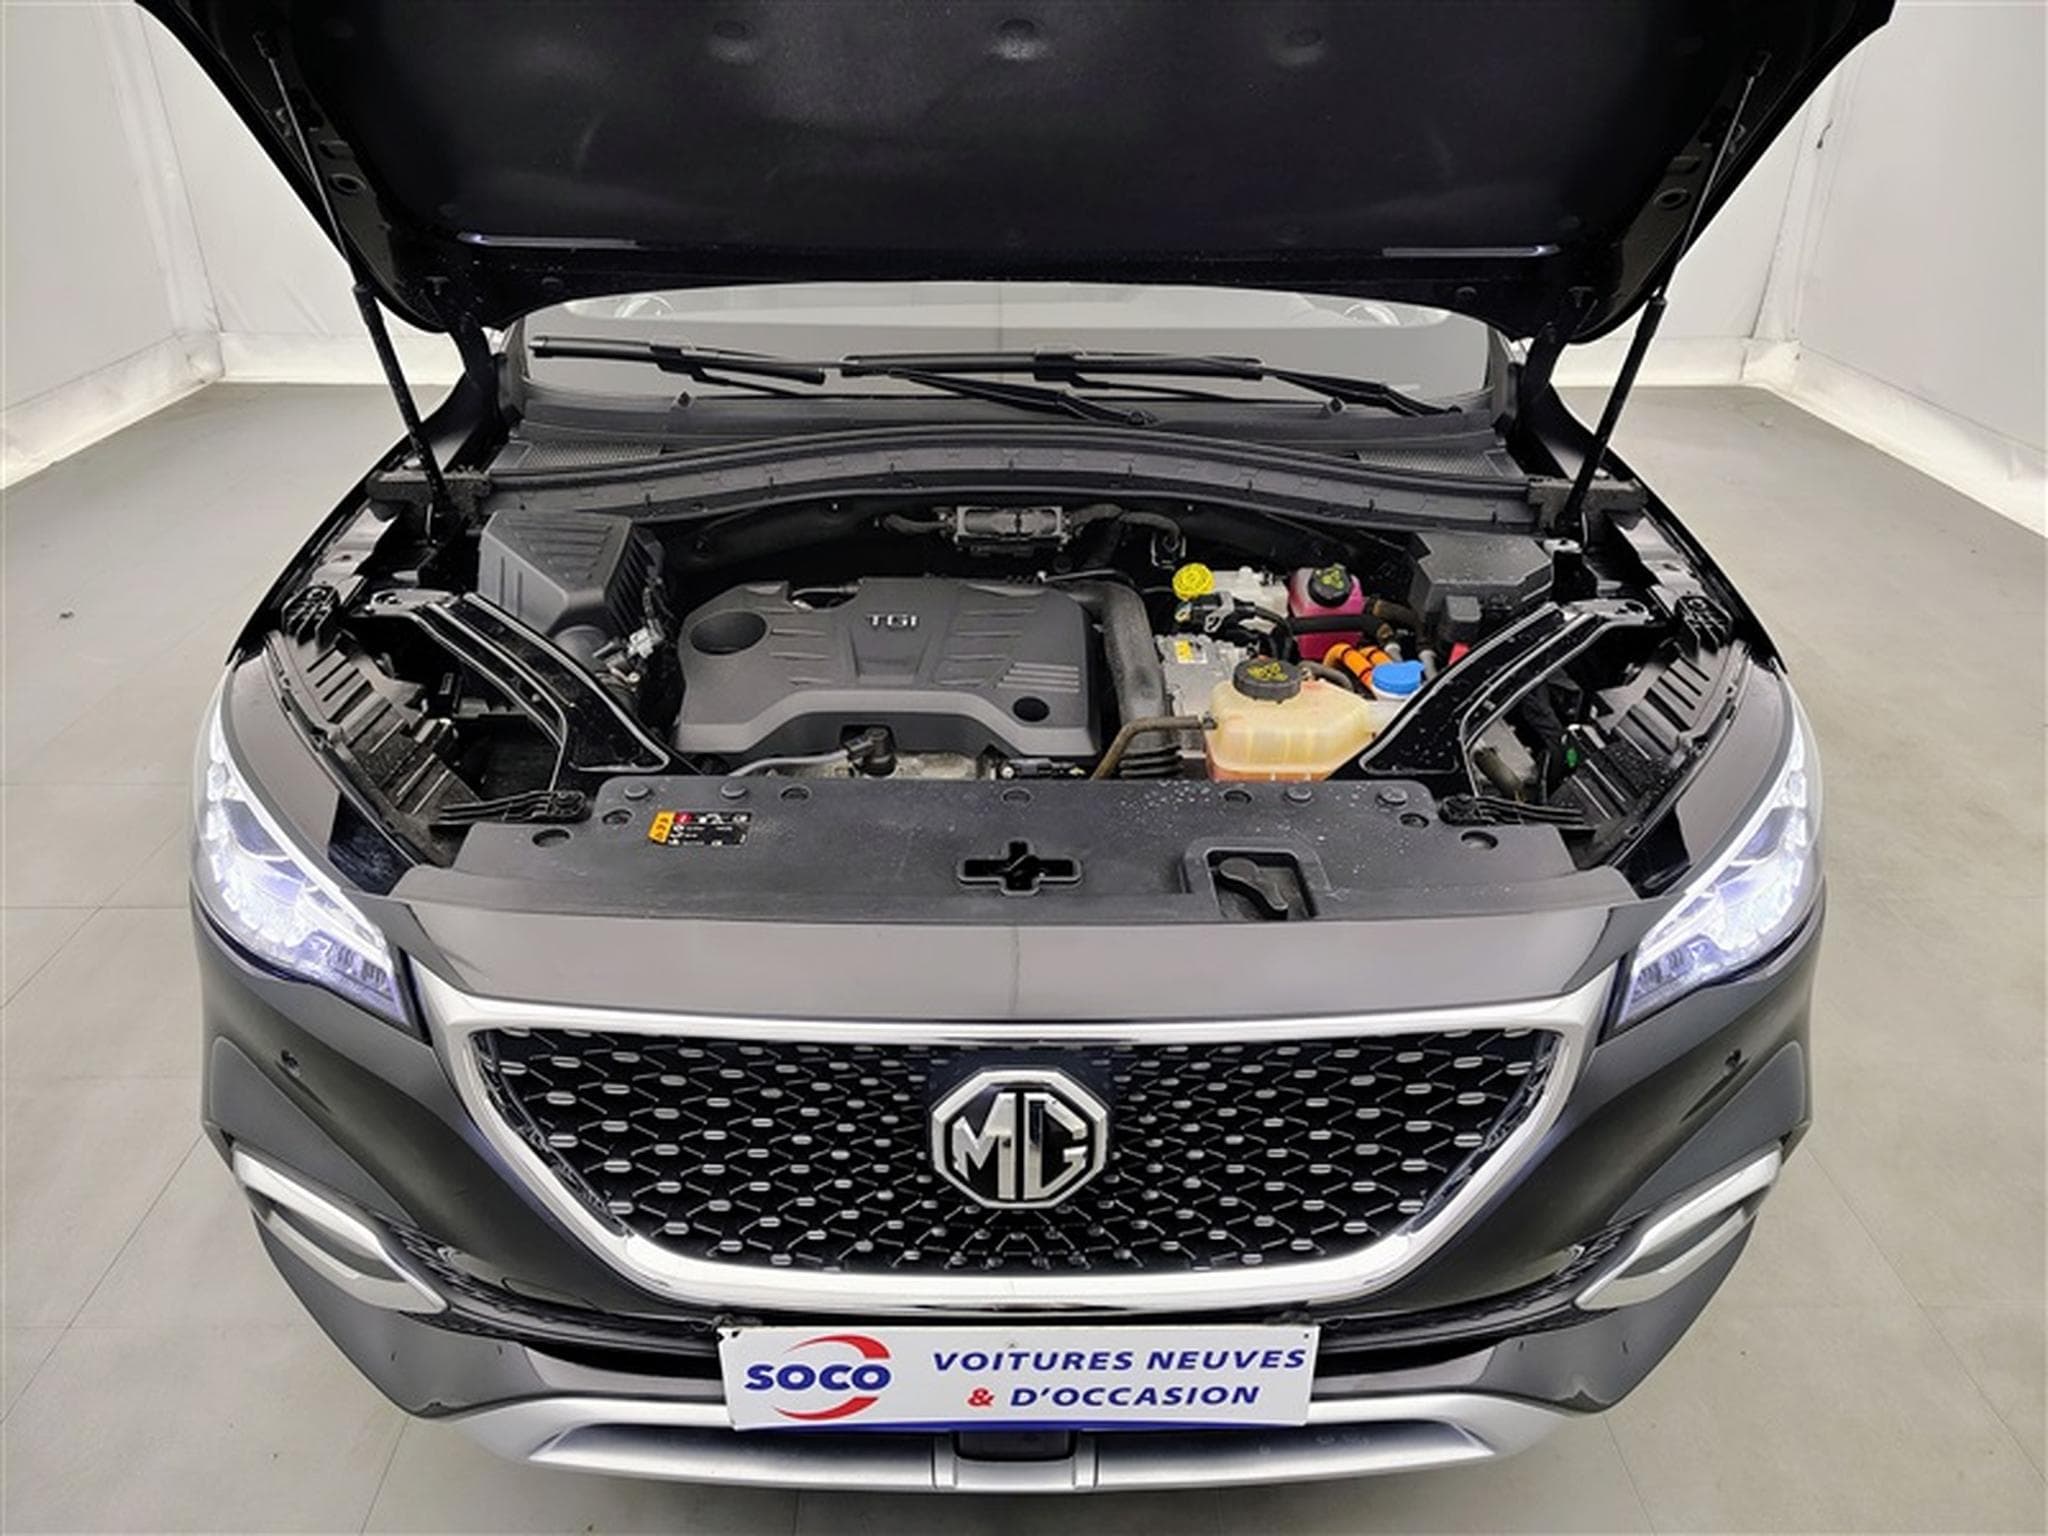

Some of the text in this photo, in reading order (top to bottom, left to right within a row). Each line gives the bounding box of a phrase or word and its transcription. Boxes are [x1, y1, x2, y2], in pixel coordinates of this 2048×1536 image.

[952, 1092, 1088, 1200] MG
[933, 1349, 1306, 1371] VOITURES NEUVES
[744, 1363, 891, 1391] SOCO
[967, 1386, 1260, 1407] & D'OCCASION
